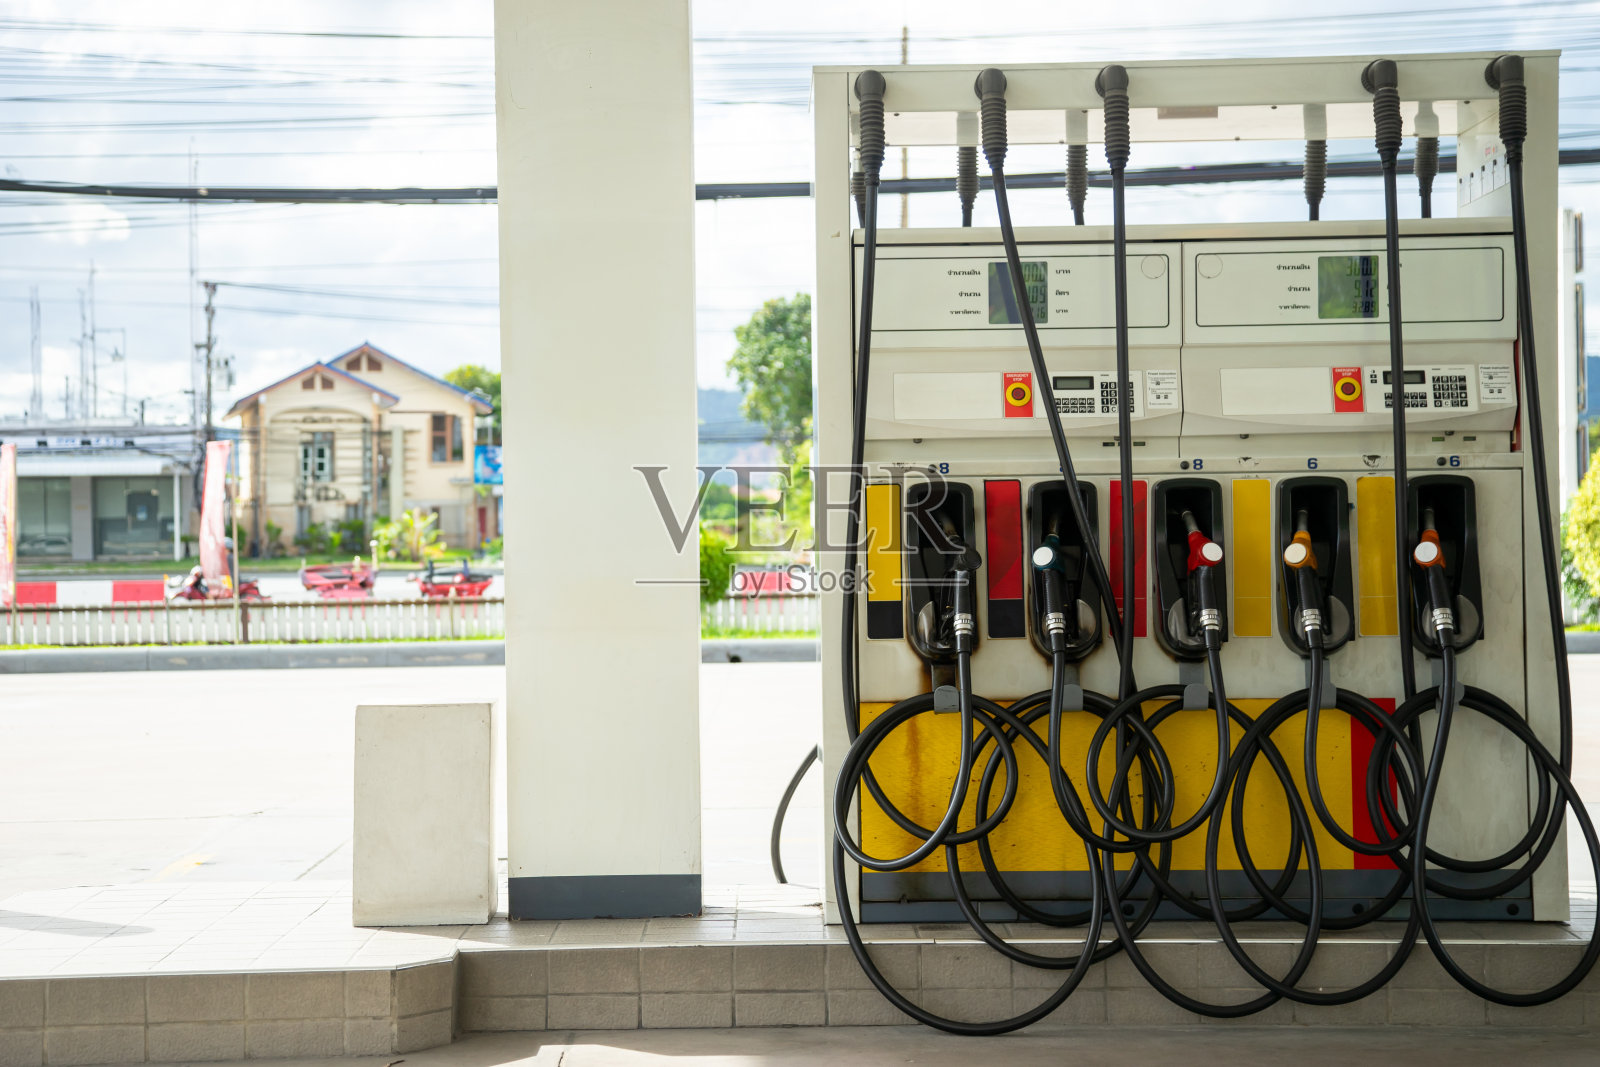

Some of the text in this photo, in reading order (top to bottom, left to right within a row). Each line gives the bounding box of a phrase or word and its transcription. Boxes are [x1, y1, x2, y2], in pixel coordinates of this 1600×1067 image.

[1192, 458, 1204, 470] 8
[1307, 457, 1319, 470] 6
[1448, 455, 1461, 468] 6
[939, 462, 950, 475] 8
